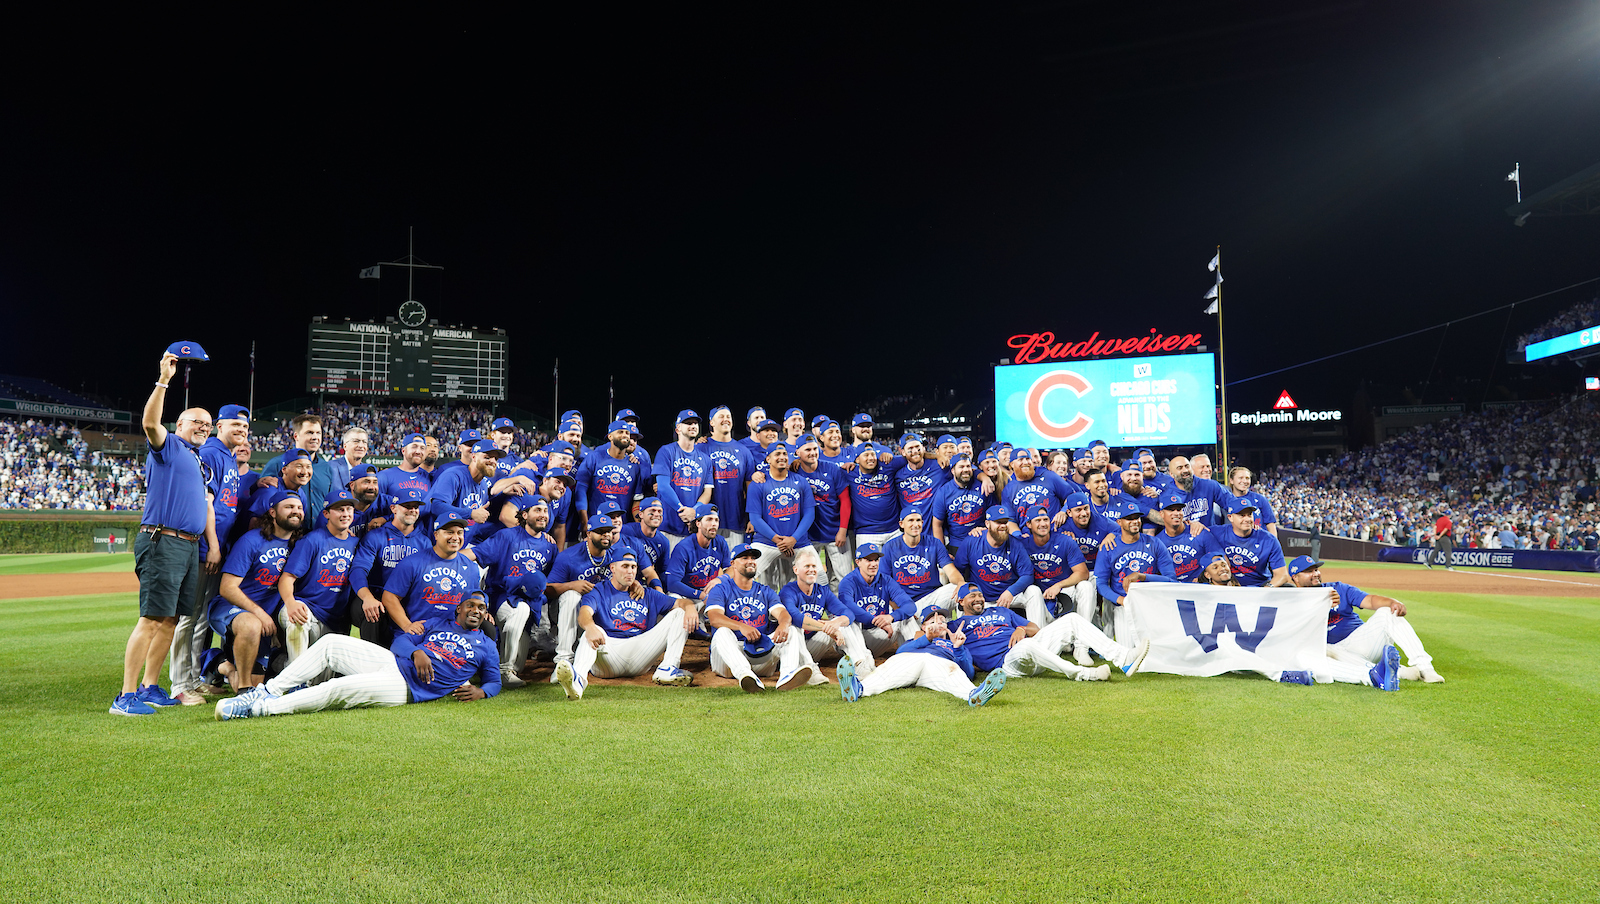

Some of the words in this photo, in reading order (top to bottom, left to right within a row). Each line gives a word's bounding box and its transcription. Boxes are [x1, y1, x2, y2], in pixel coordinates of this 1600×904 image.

[350, 323, 391, 334] NATIONAL
[433, 329, 472, 339] AMERICAN
[181, 346, 190, 354] C
[1007, 328, 1201, 364] Budweiser
[1138, 366, 1148, 374] W
[1110, 381, 1150, 396] CHICAGO
[1152, 379, 1177, 394] CUBS
[16, 402, 115, 420] WRIGLEYROOFTOPS.COM
[1024, 370, 1095, 442] C
[1118, 403, 1171, 434] NLDS
[1231, 410, 1293, 426] Benjamin
[1296, 409, 1342, 422] Moore
[597, 464, 632, 483] OCTOBER
[766, 486, 800, 502] OCTOBER
[948, 494, 984, 511] OCTOBER
[1013, 485, 1049, 504] OCTOBER
[894, 554, 930, 570] OCTOBER
[1114, 551, 1154, 570] OCTOBER
[1492, 555, 1513, 564] 2025
[422, 567, 468, 590] OCTOBER
[610, 600, 648, 616] OCTOBER
[1176, 600, 1278, 653] W
[428, 632, 475, 660] OCTOBER
